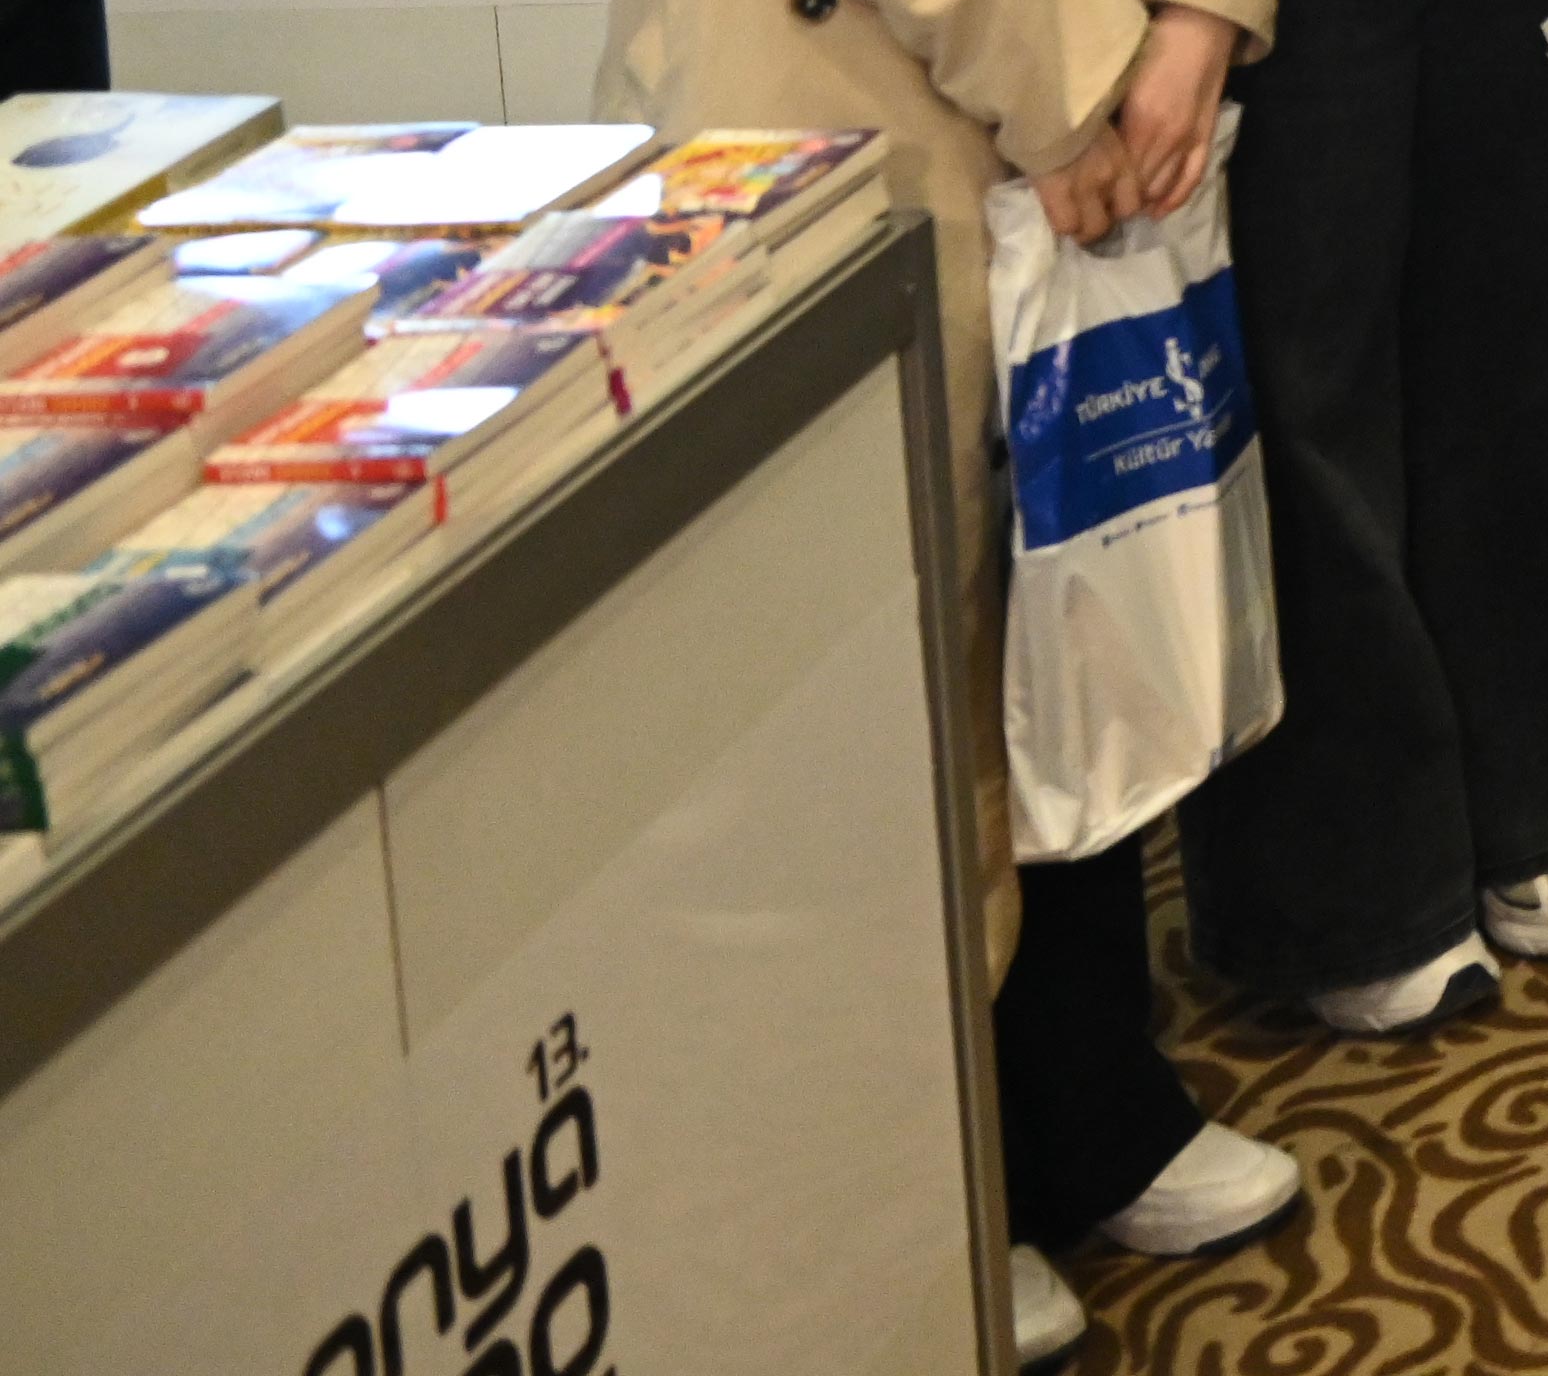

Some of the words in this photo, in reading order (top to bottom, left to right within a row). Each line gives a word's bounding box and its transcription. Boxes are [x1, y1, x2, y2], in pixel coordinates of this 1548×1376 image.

[1075, 376, 1170, 426] TÜRKİYE
[1113, 437, 1184, 476] Kültür
[303, 1084, 599, 1376] nya
